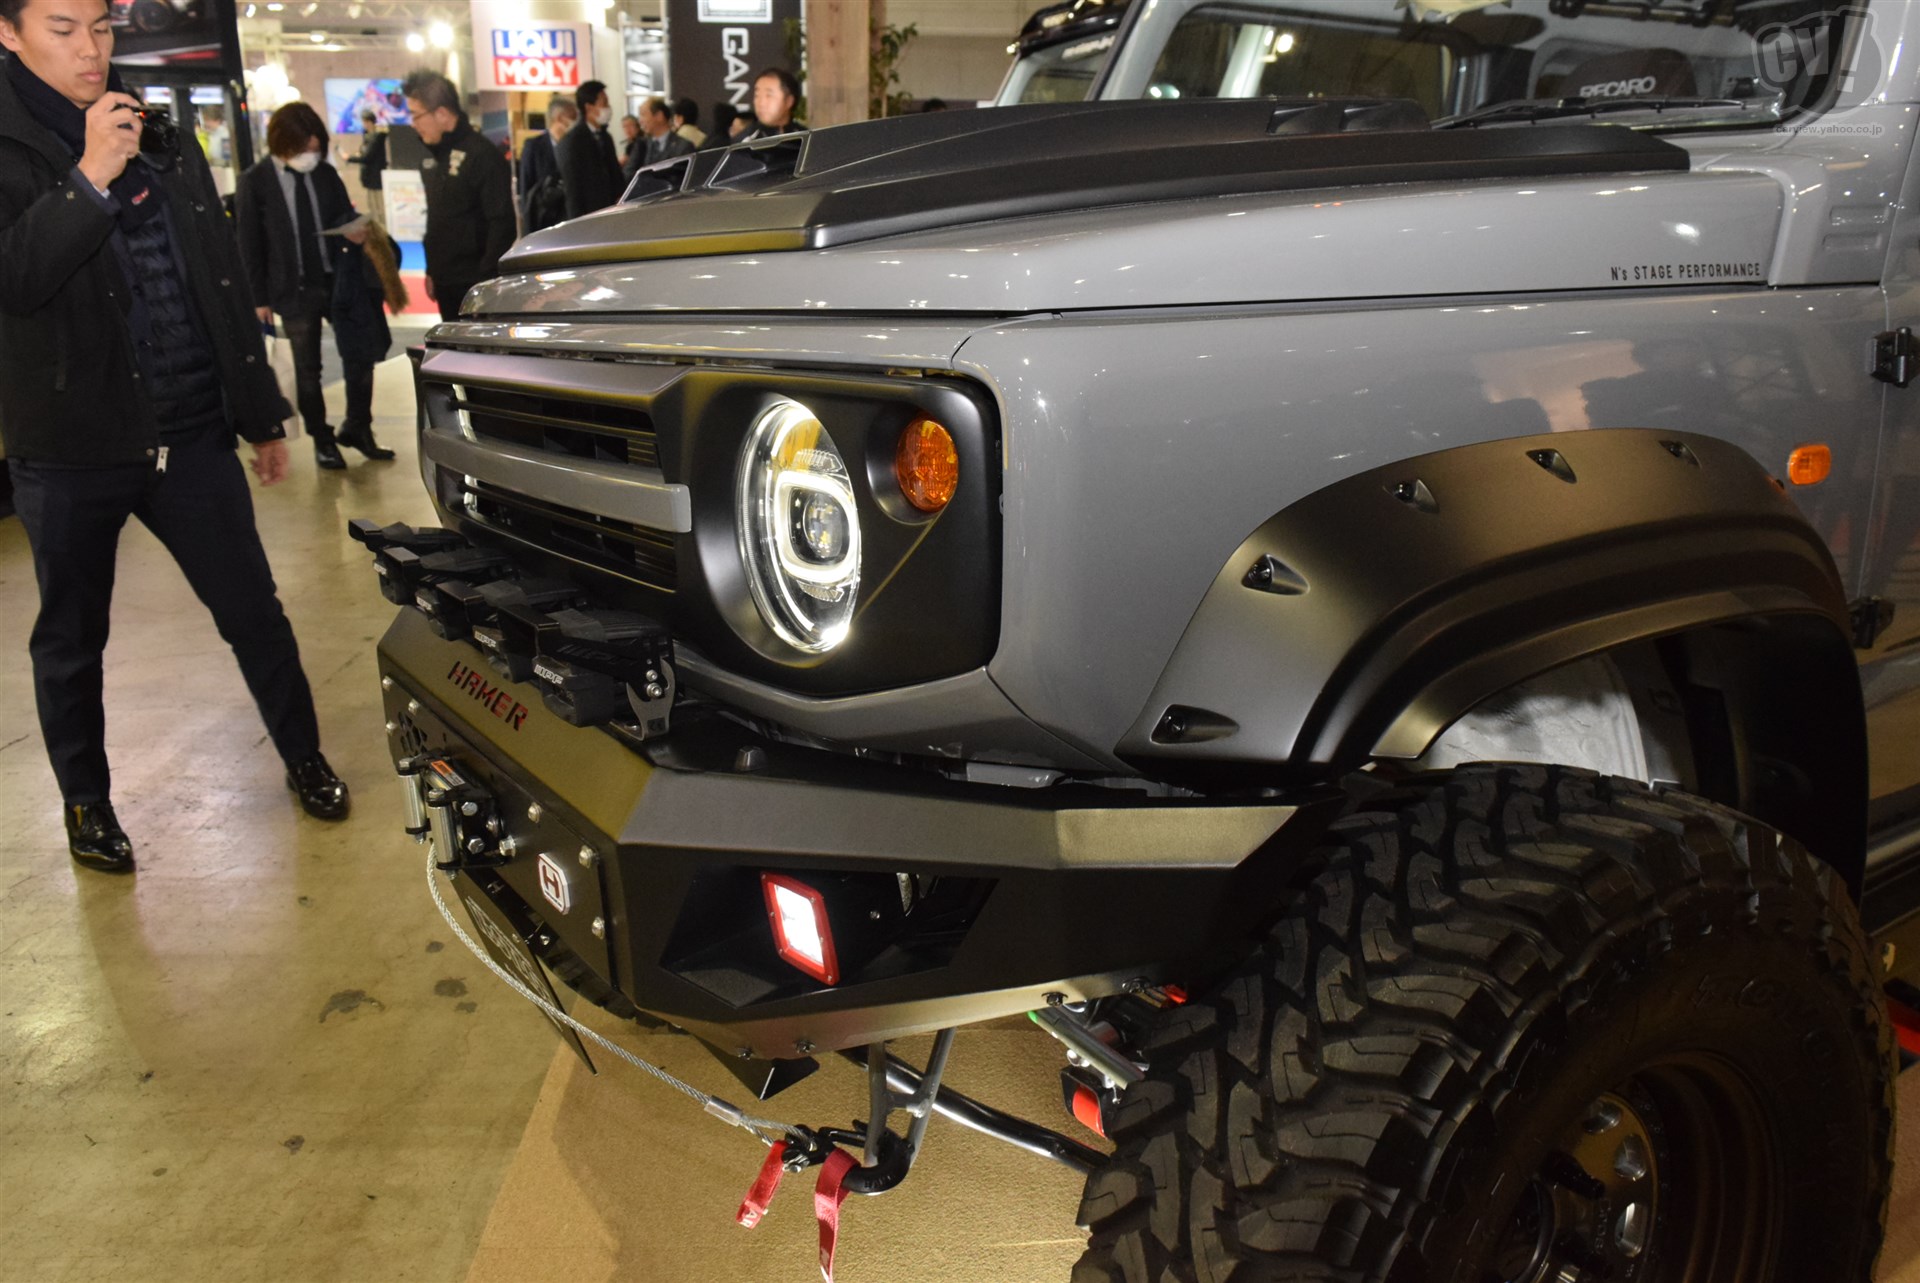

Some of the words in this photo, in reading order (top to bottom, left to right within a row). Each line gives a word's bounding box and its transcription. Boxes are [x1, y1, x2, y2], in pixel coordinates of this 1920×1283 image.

[494, 29, 575, 56] LIQUI
[496, 57, 577, 85] MOLY
[1611, 266, 1628, 281] N's
[1634, 264, 1673, 280] STAGE
[1679, 262, 1761, 278] PERFORMANCE
[447, 660, 529, 731] HAMER
